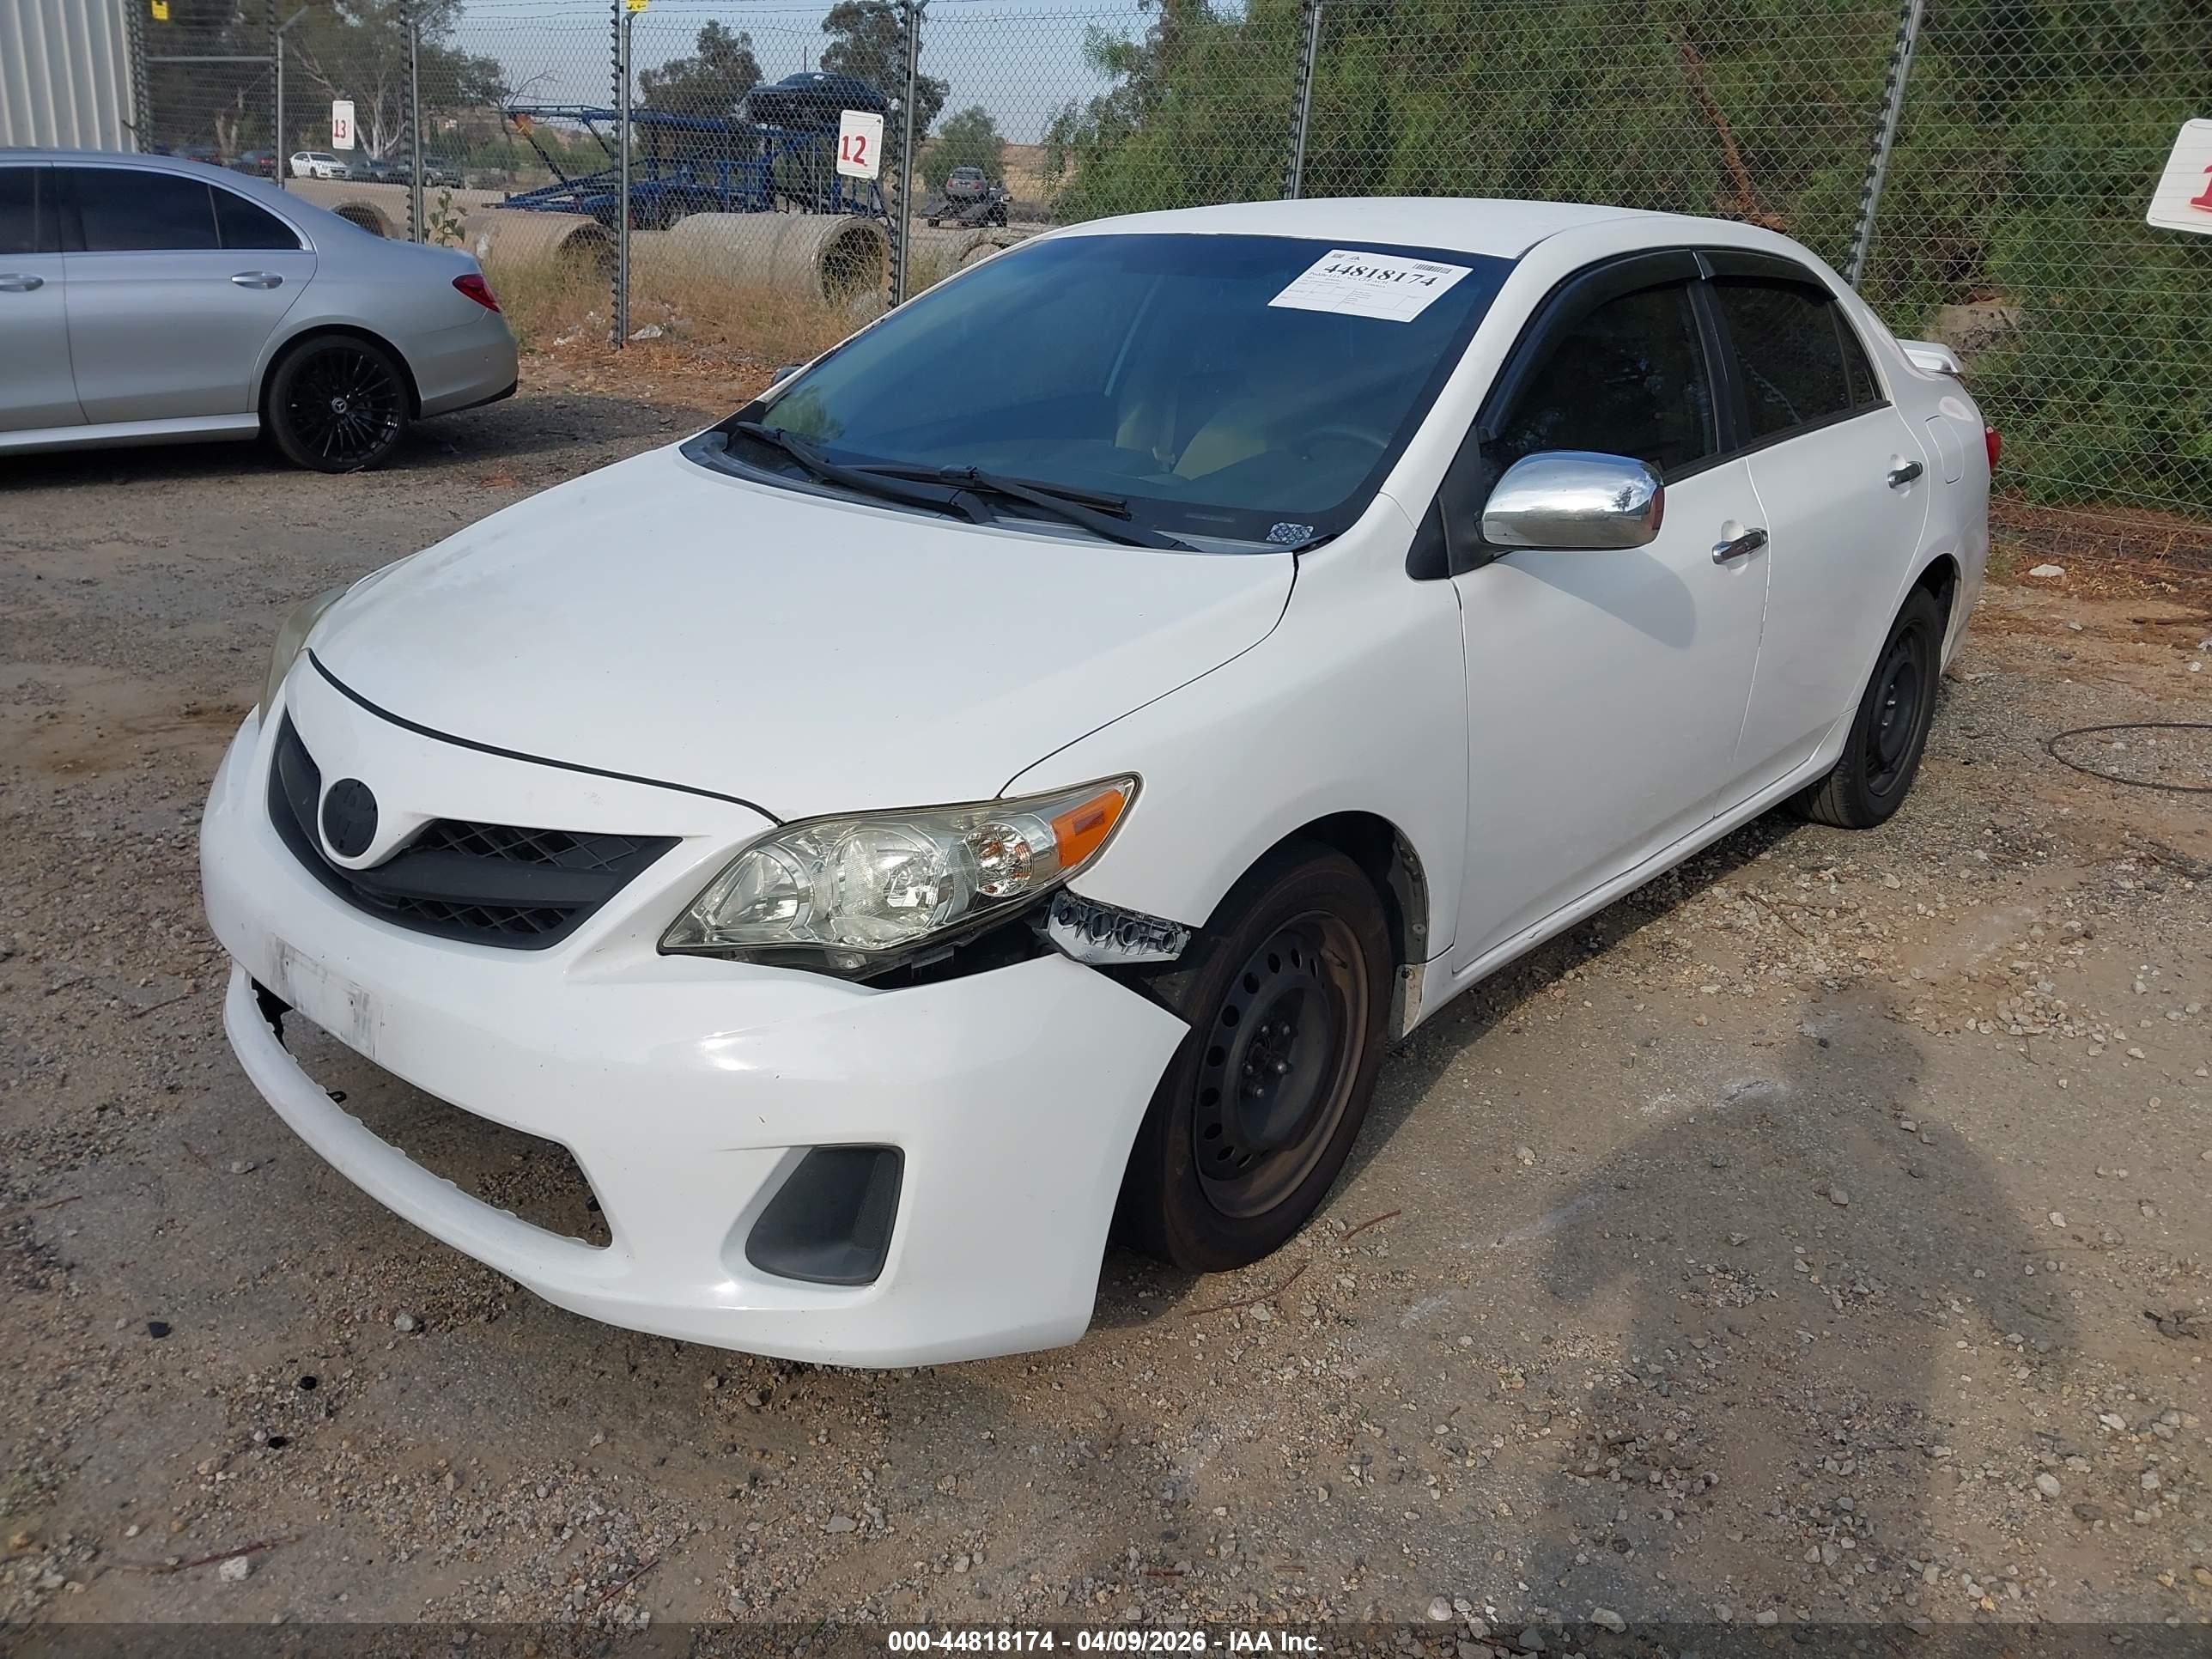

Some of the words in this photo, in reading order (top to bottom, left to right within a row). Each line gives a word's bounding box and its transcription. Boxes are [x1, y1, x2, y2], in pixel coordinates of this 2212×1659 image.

[334, 118, 346, 138] 13
[842, 135, 867, 165] 12
[1323, 263, 1439, 287] 44818174
